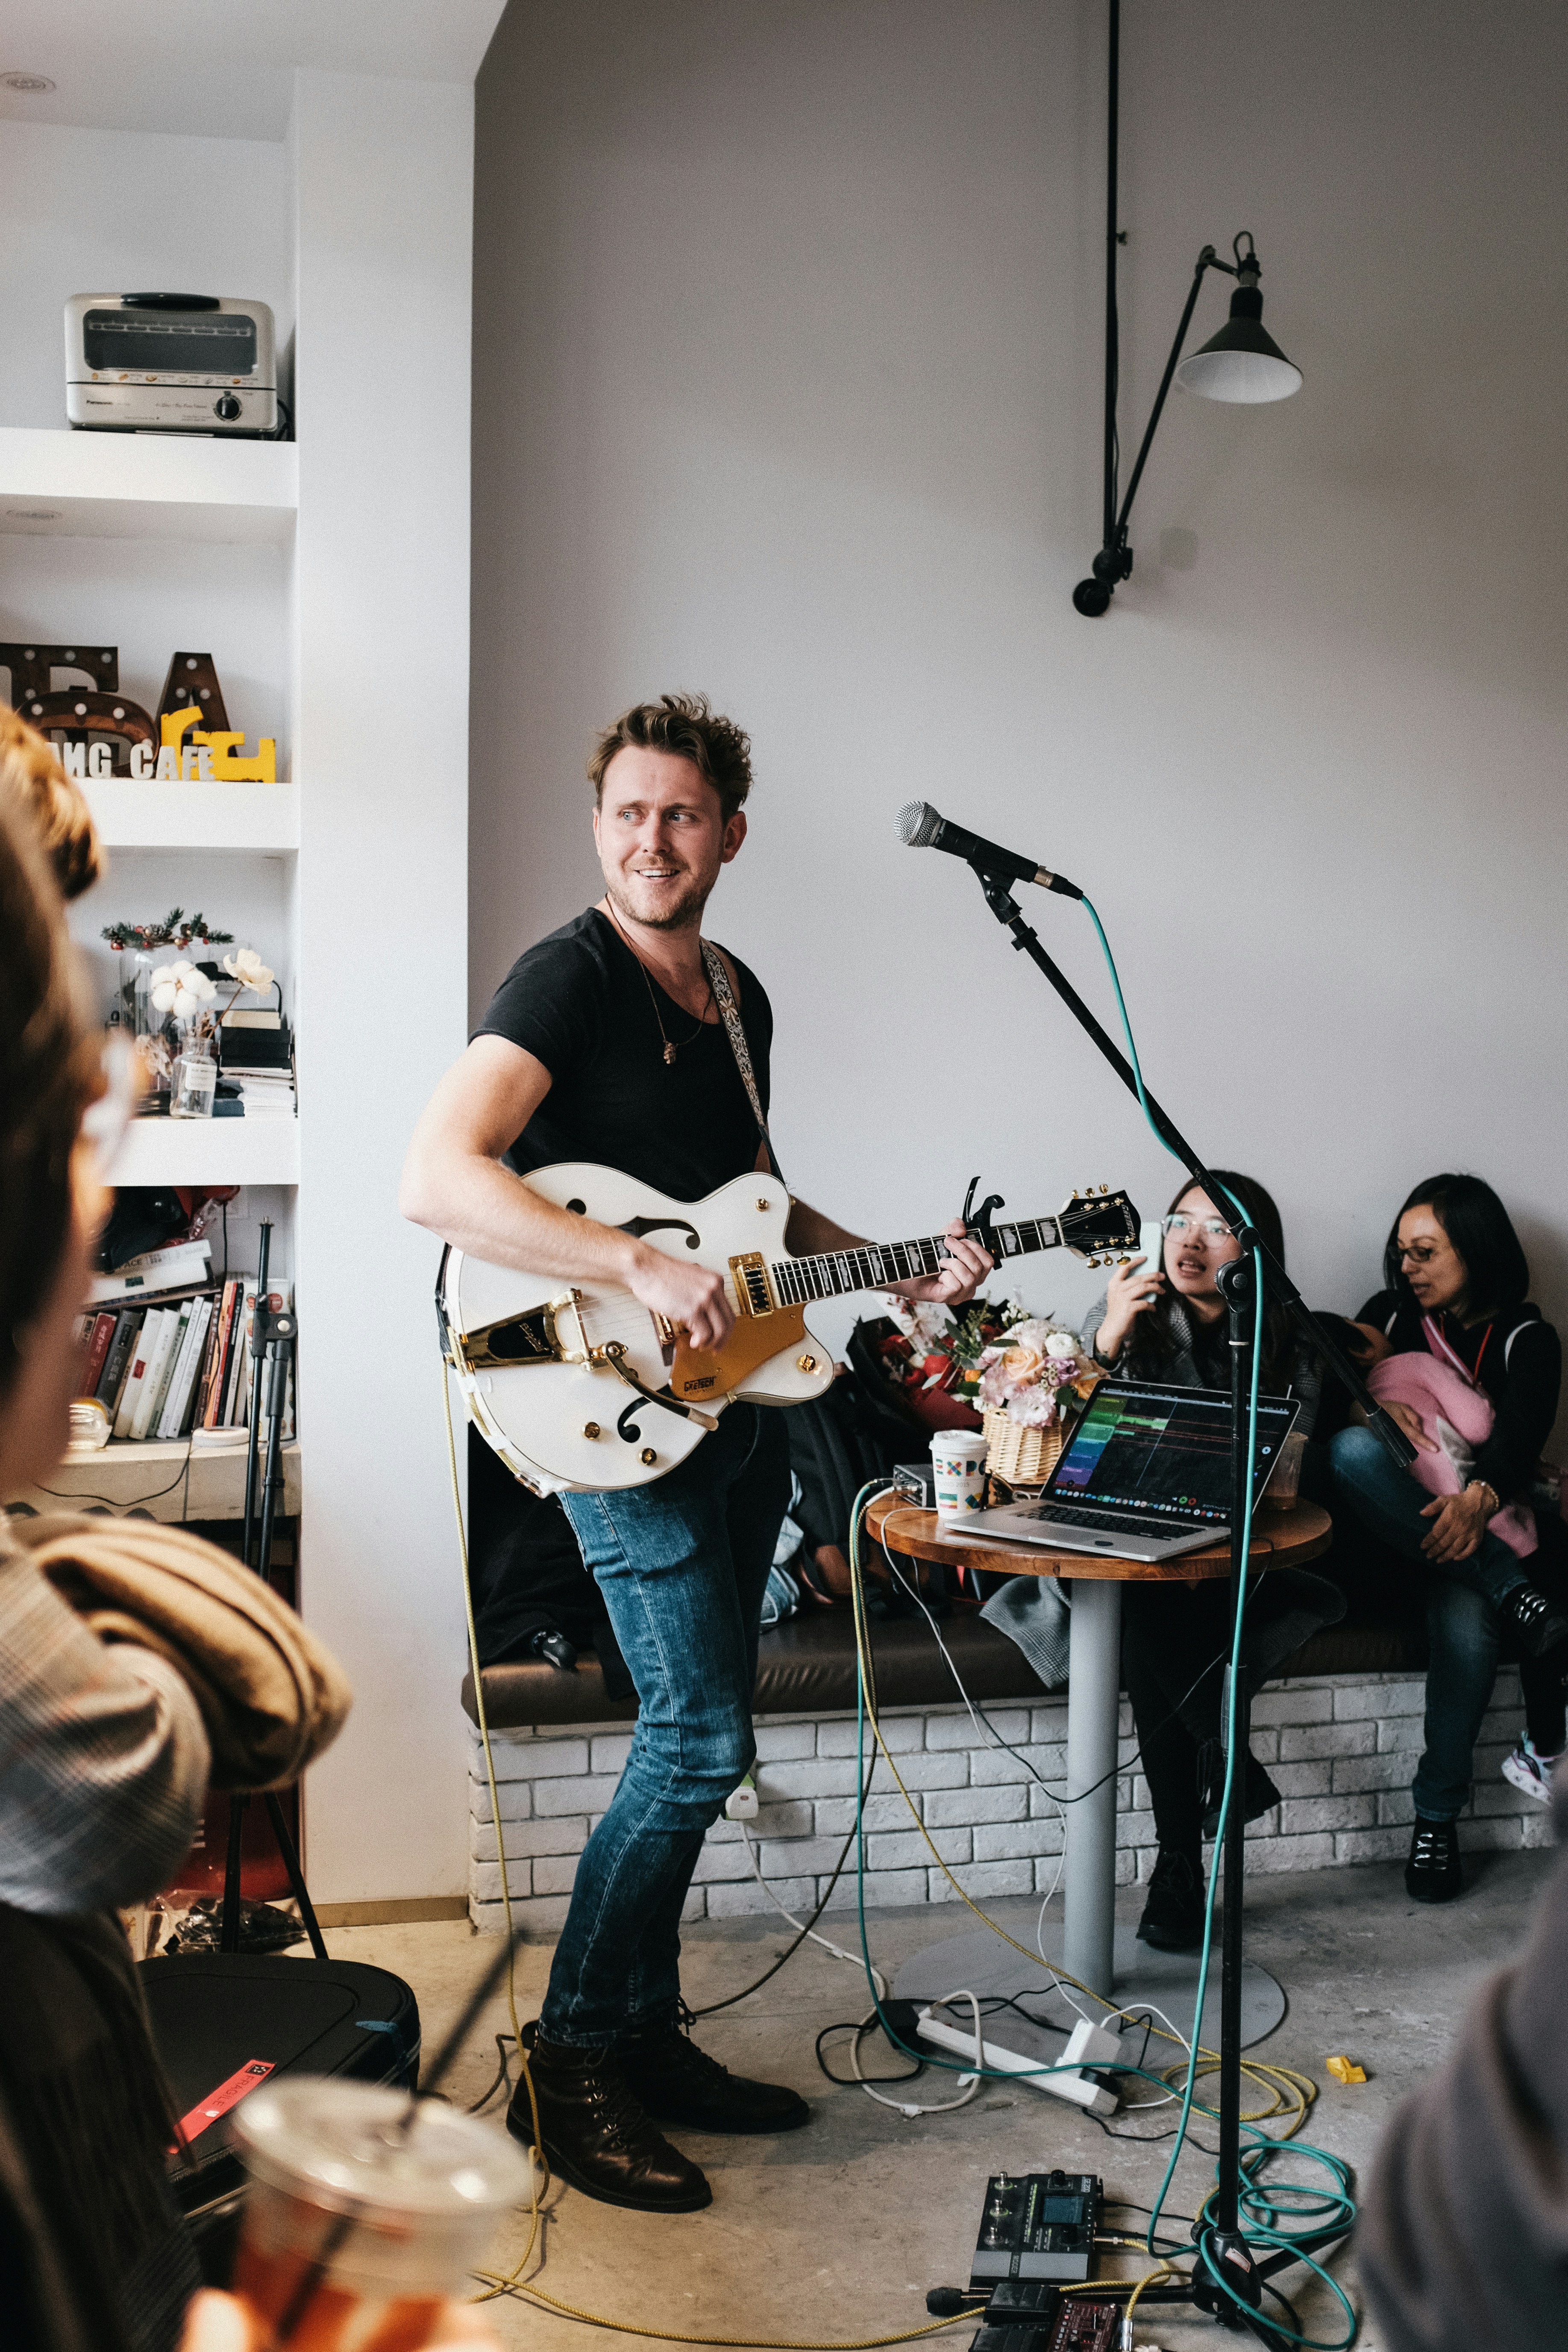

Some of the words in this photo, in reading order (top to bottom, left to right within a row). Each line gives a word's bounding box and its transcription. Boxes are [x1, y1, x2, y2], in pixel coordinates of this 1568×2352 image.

[130, 743, 215, 781] CAFE
[1122, 1204, 1136, 1238] GRETSCH
[684, 1376, 716, 1392] GRETSCH
[213, 2075, 255, 2106] FRAGILE
